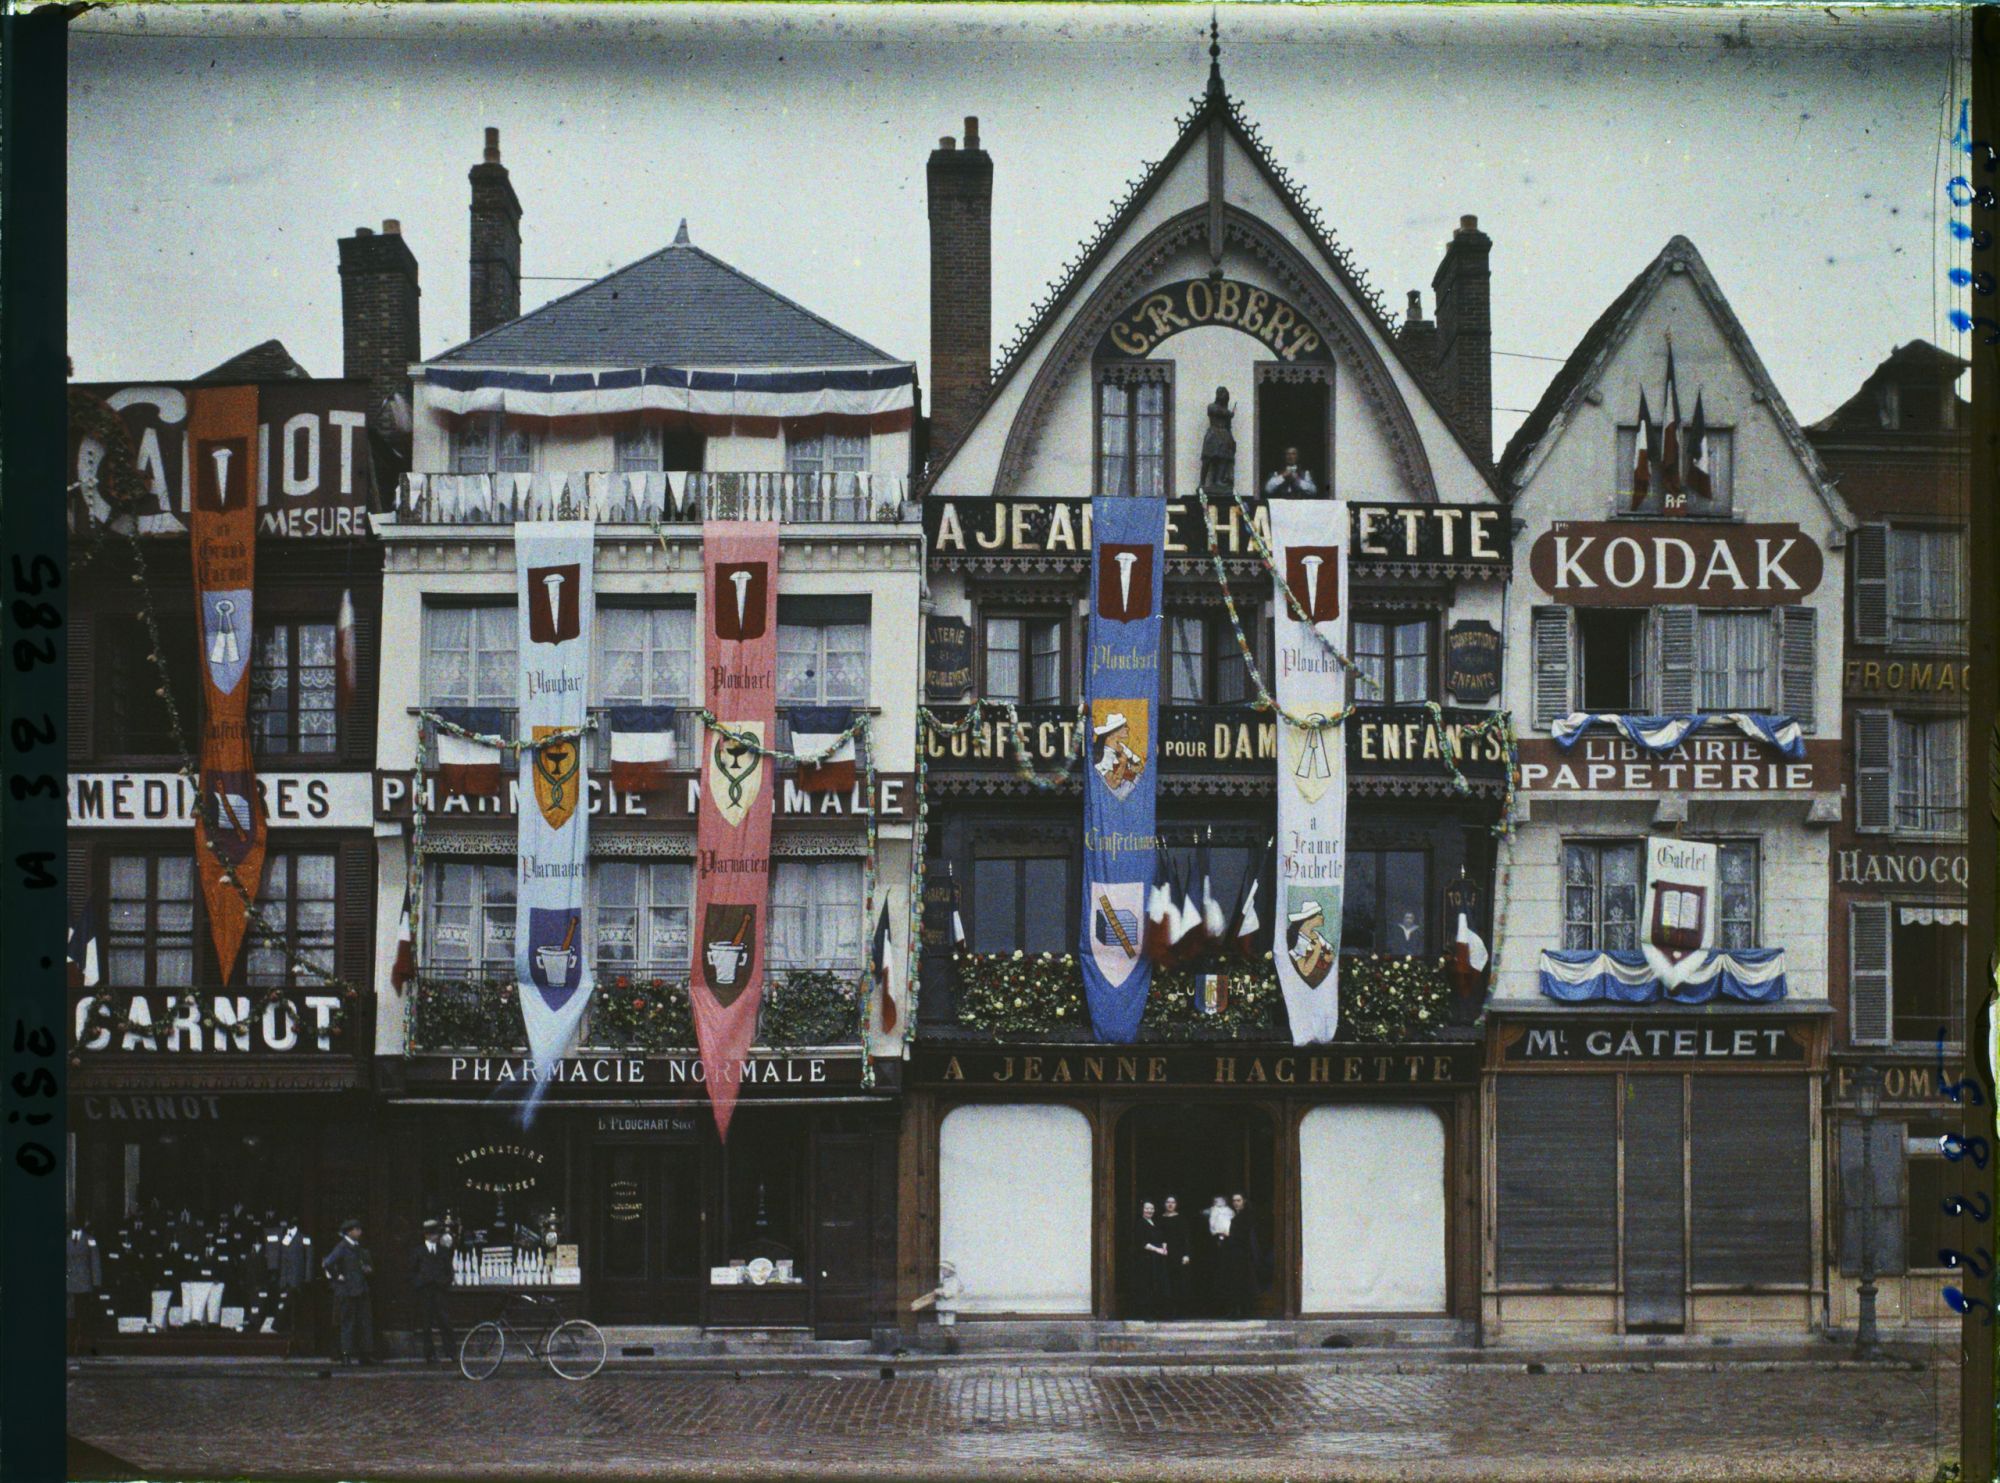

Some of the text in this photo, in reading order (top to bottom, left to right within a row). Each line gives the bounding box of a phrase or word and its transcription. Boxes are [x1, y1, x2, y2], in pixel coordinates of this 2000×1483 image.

[1132, 280, 1320, 361] ROBERT
[77, 387, 366, 533] CAOT
[258, 505, 367, 537] MESURE
[936, 502, 1499, 559] A JEAE HAETTE
[1554, 536, 1801, 590] KODAK
[1165, 741, 1208, 757] POUR
[1214, 723, 1277, 759] DAM
[1361, 723, 1501, 761] ENFANTS
[1520, 764, 1814, 789] PAPETERIE
[75, 996, 341, 1051] CARNOT
[1586, 1030, 1786, 1056] GATELET
[451, 1058, 826, 1083] PHARMACIE NORMALE
[943, 1056, 1454, 1083] A JEANNE HACHETTE
[84, 1096, 221, 1119] CARNOT
[611, 1116, 669, 1130] PLOUCHART
[456, 1145, 544, 1164] LABORATOIRE
